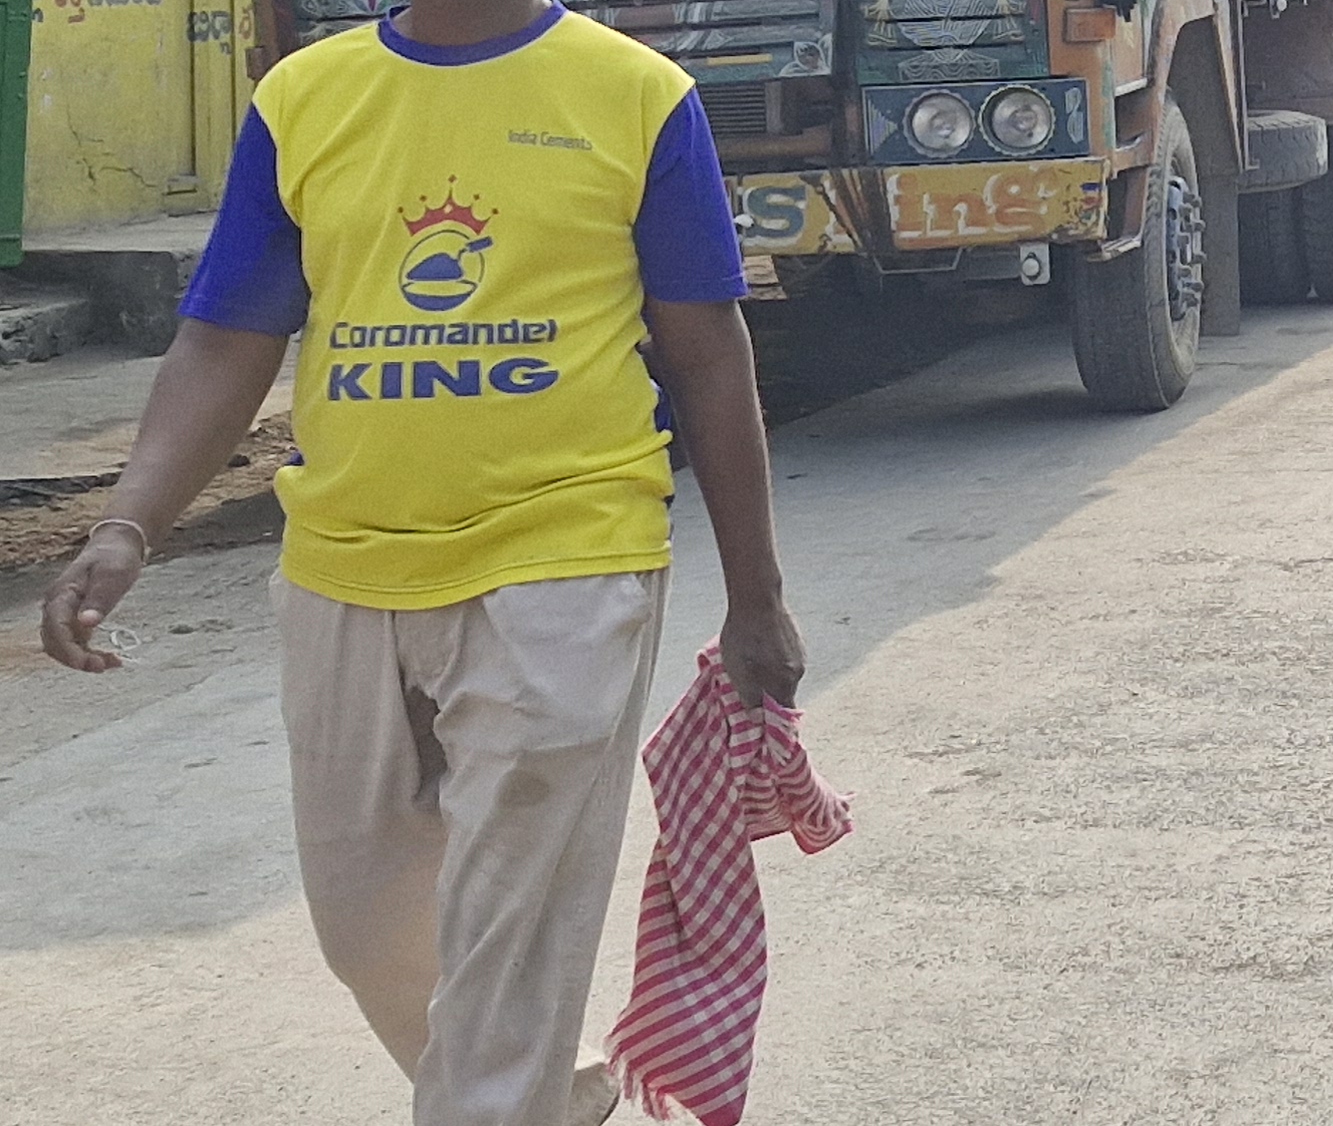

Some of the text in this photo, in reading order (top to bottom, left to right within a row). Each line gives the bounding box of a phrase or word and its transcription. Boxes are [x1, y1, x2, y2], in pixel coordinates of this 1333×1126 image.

[507, 129, 593, 152] India Cements
[330, 318, 559, 350] Coromandel
[328, 356, 560, 402] KING
